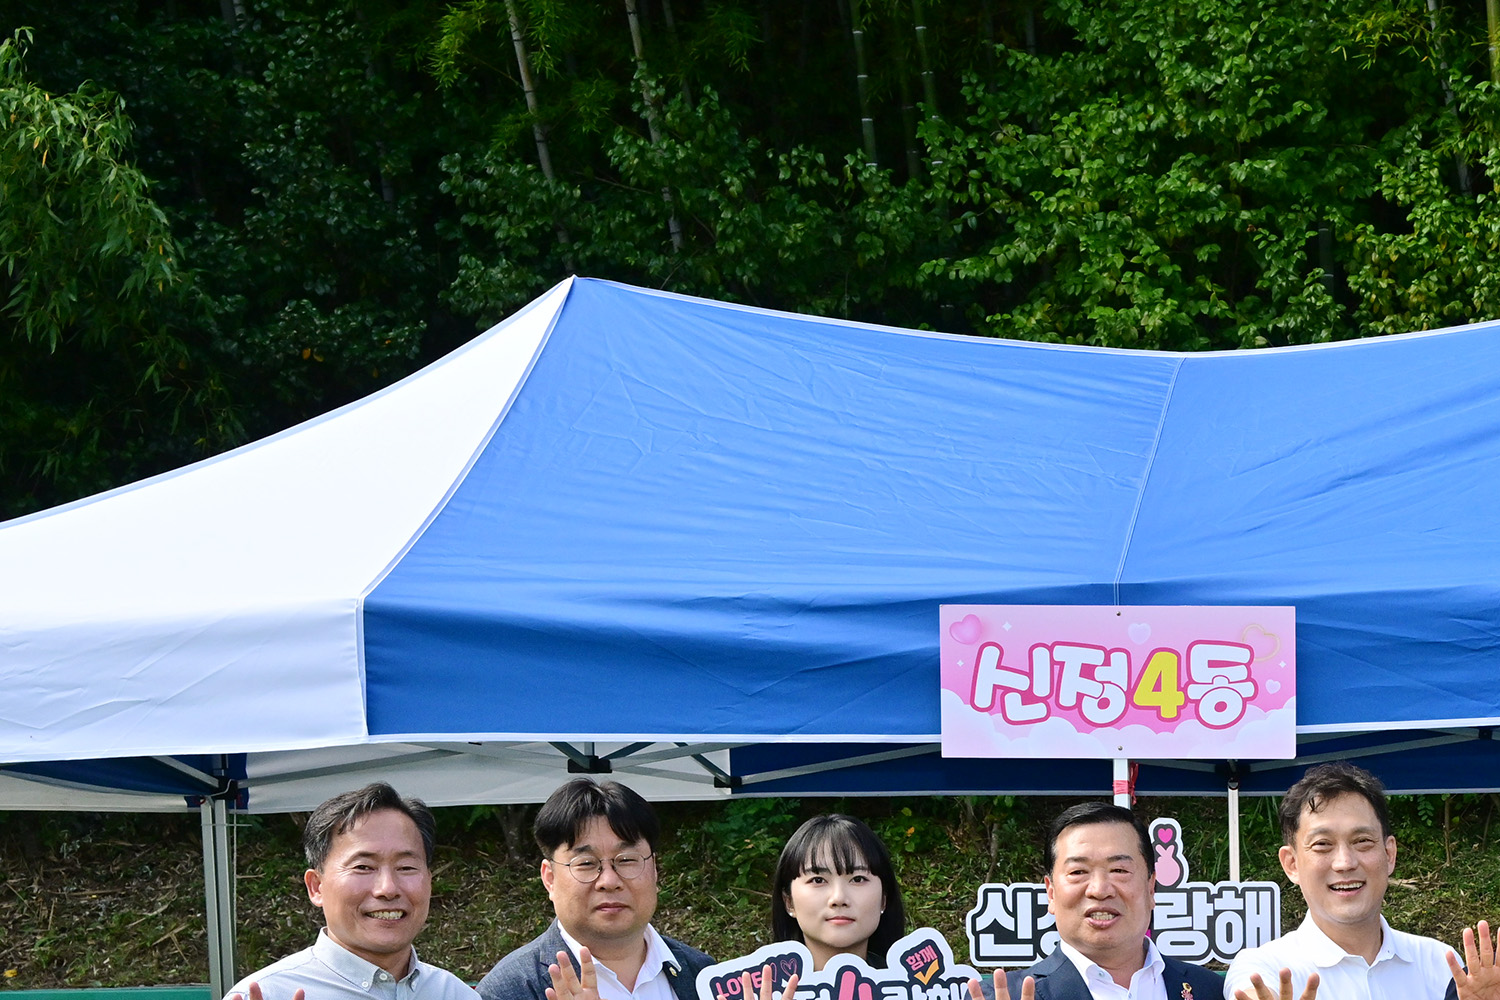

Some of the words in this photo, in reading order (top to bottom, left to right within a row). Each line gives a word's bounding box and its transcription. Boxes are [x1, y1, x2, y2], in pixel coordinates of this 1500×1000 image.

[970, 639, 1258, 730] 신정4동
[905, 944, 938, 971] 함께
[975, 890, 1272, 958] 신랑해
